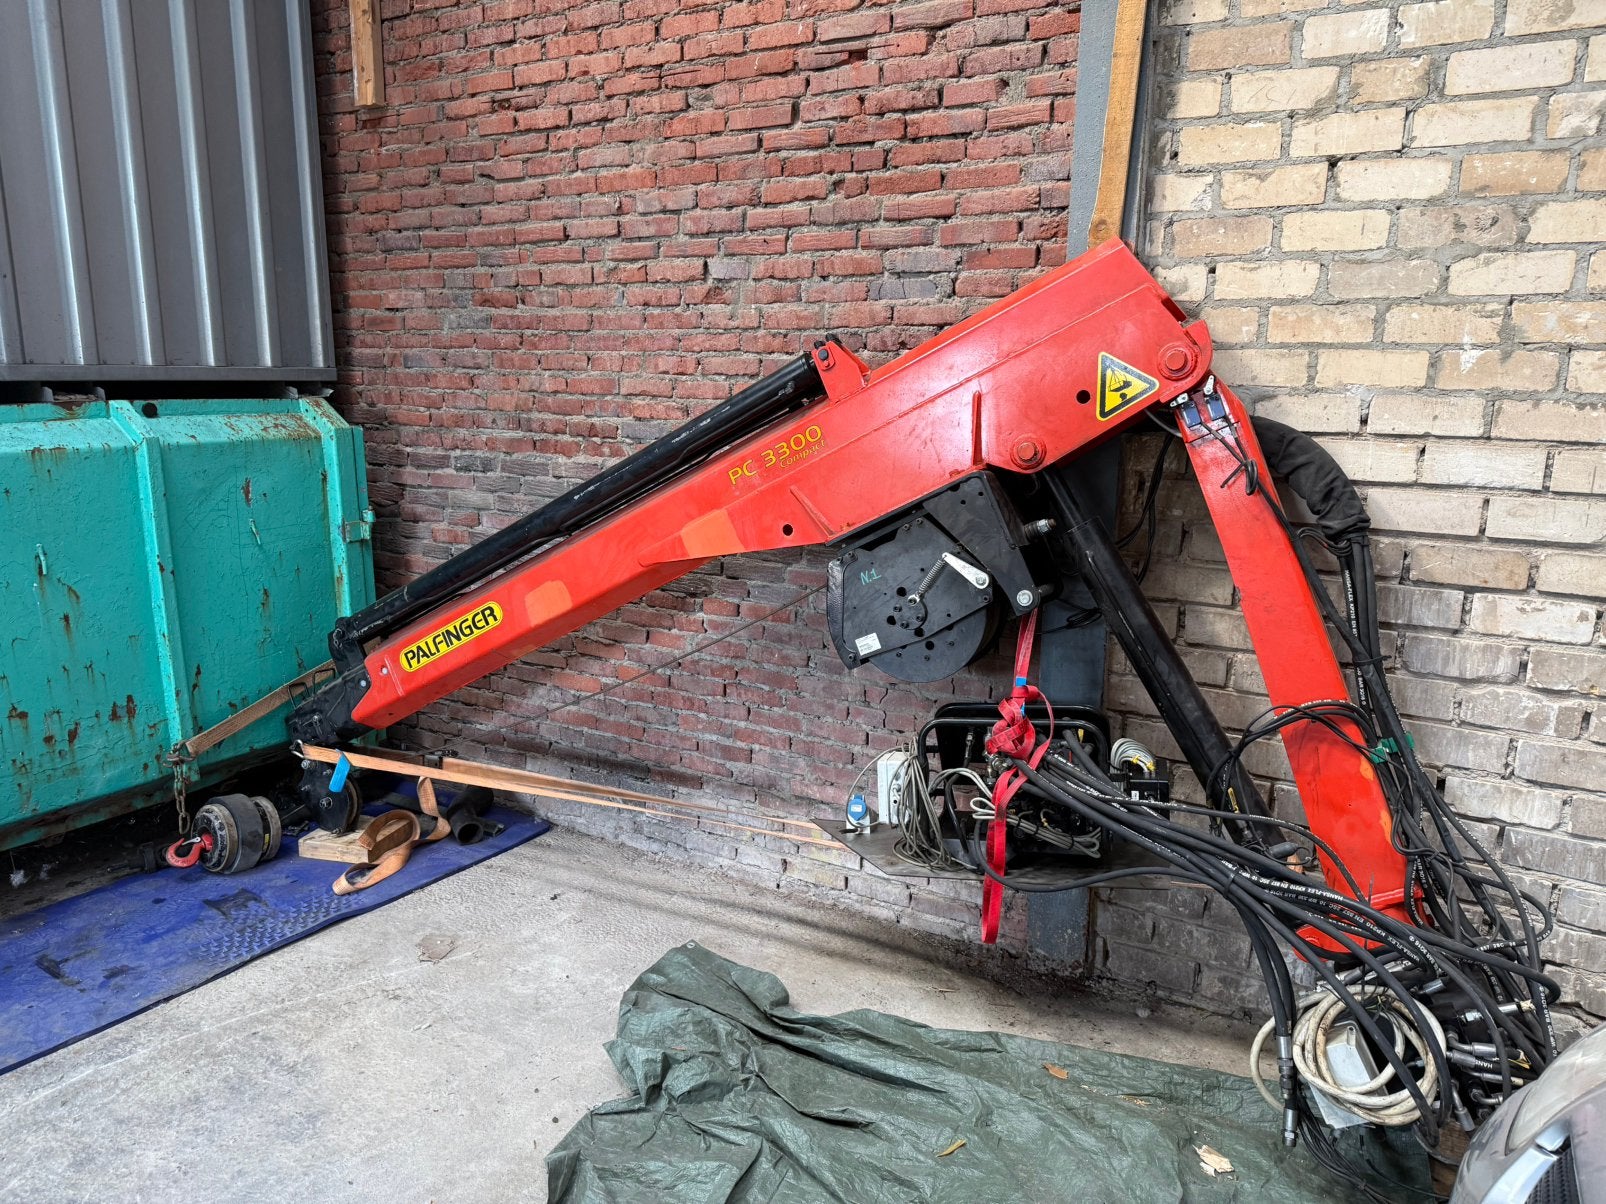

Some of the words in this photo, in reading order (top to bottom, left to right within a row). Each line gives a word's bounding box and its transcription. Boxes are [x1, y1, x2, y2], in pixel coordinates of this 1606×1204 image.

[728, 459, 757, 485] PC
[761, 425, 822, 468] 3300
[780, 440, 825, 468] Compact
[404, 606, 498, 668] PALFINGER
[1306, 887, 1345, 901] HANSA-FLEX
[1354, 914, 1364, 924] EN
[1366, 922, 1386, 938] KP210
[1543, 1009, 1551, 1023] BAR
